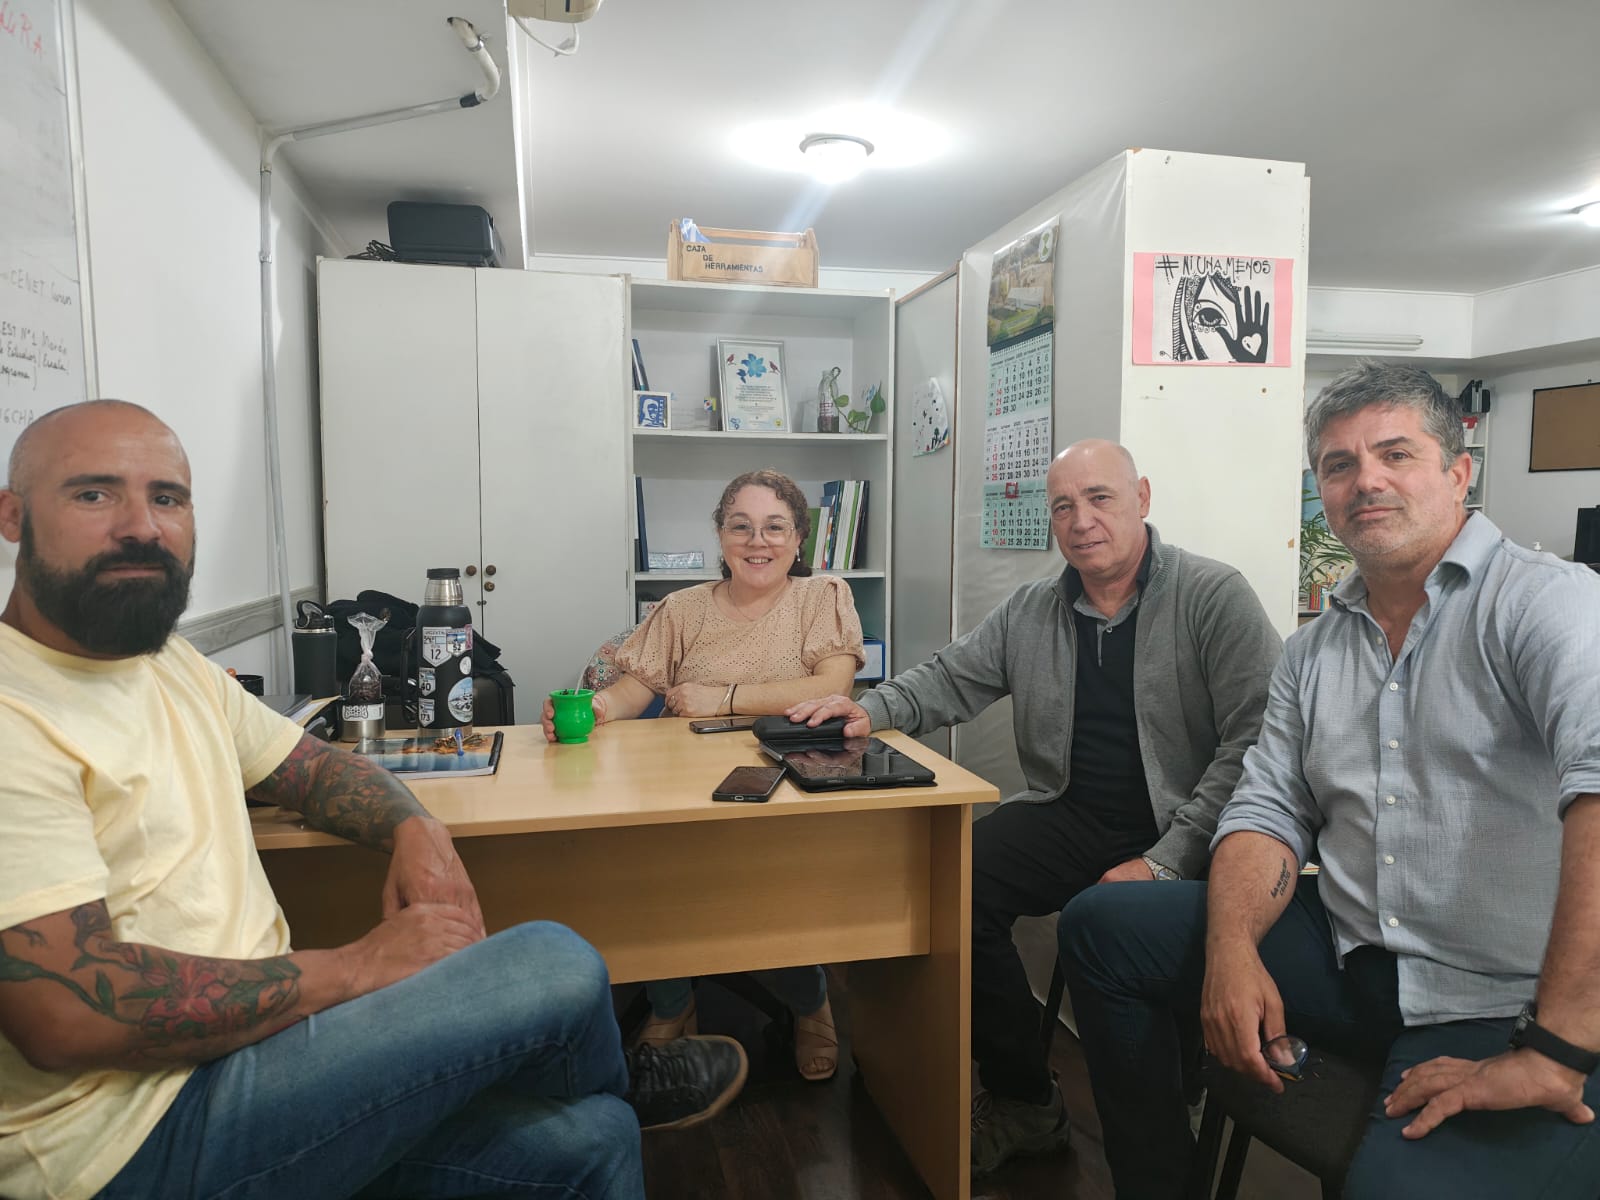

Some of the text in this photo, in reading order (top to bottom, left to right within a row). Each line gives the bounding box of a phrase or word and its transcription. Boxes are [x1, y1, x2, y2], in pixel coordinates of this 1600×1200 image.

[686, 244, 706, 253] CAJA
[703, 254, 713, 262] DE
[705, 262, 763, 273] HERRAMIENTAS
[1223, 257, 1271, 283] MENOS
[431, 648, 441, 660] 12
